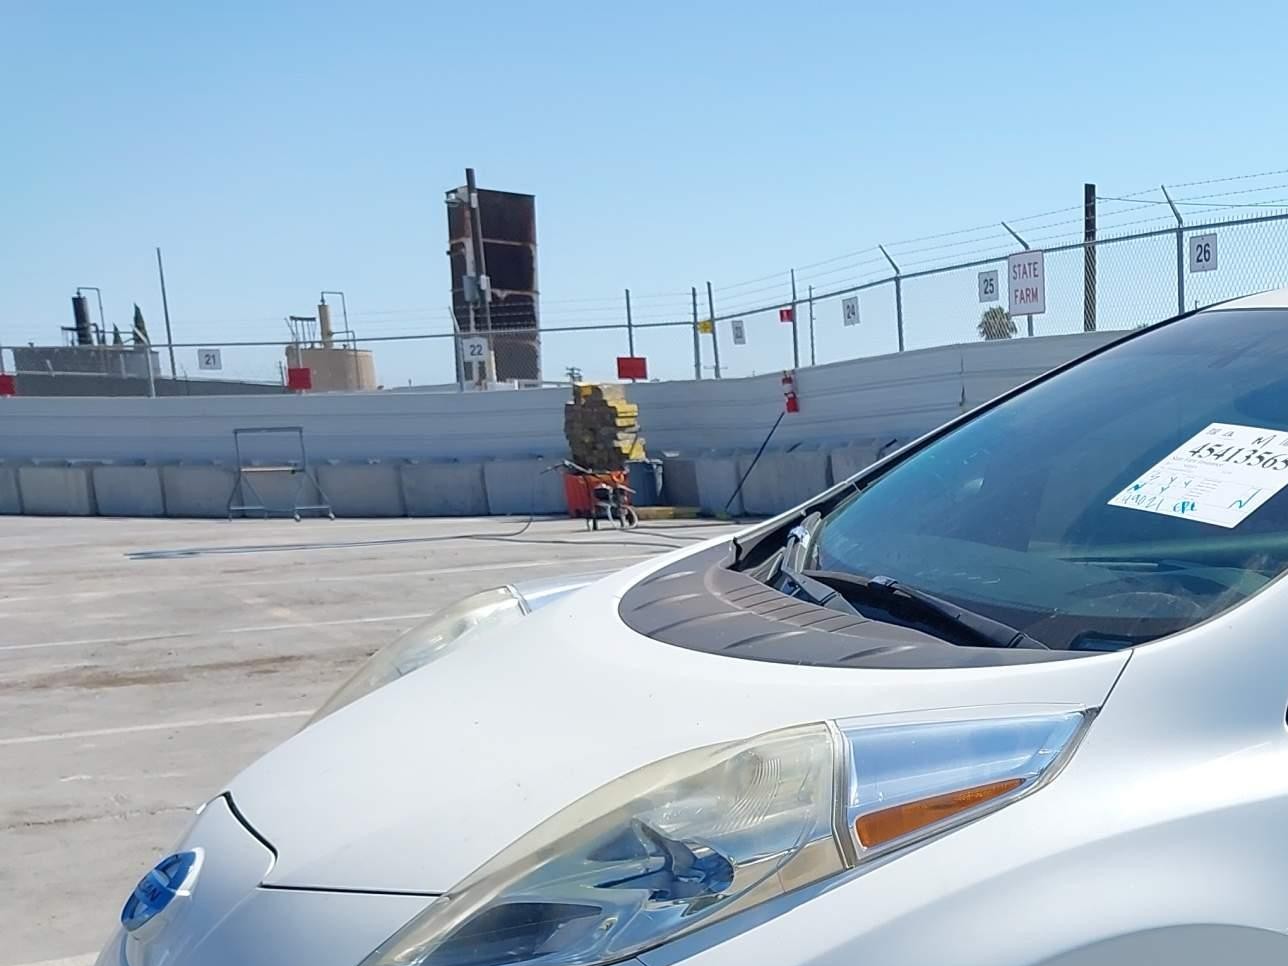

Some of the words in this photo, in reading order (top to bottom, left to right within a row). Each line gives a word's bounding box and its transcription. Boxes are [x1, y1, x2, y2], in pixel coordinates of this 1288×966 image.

[1196, 243, 1210, 263] 26
[1012, 261, 1039, 280] STATE
[983, 278, 995, 295] 25
[1014, 287, 1039, 304] FARM
[846, 303, 856, 319] 24
[469, 343, 483, 356] 22
[204, 353, 216, 366] 21
